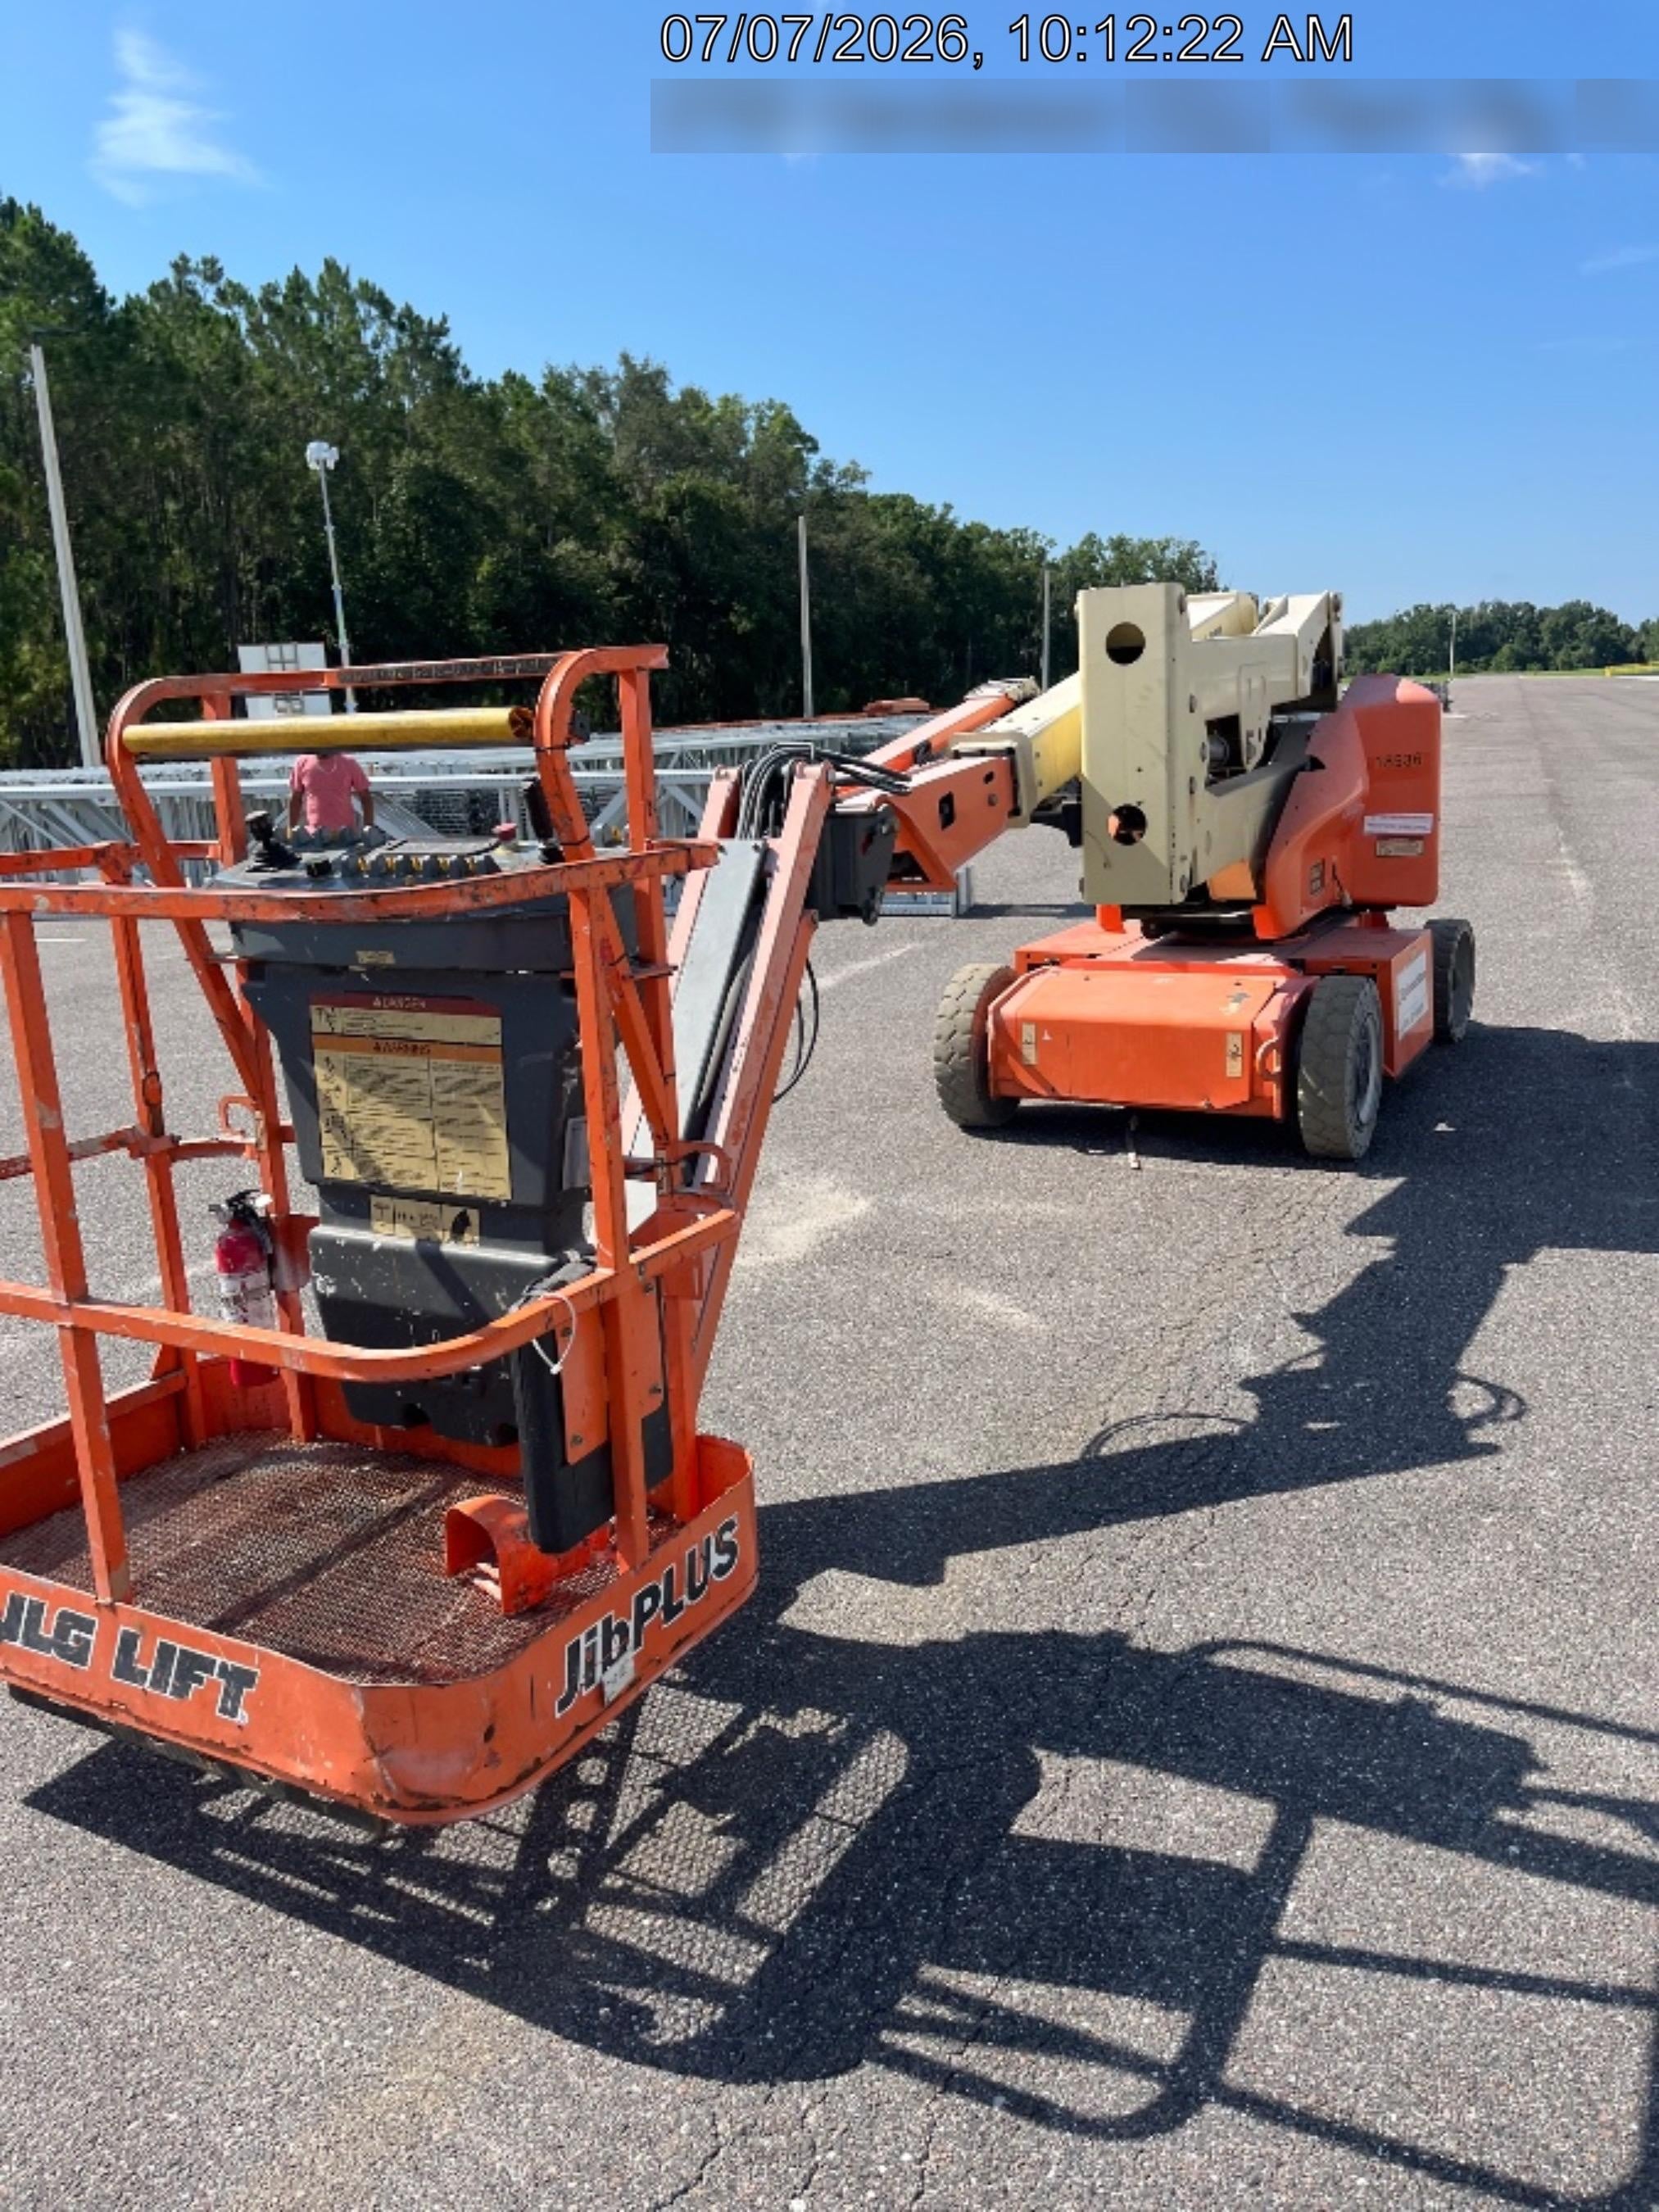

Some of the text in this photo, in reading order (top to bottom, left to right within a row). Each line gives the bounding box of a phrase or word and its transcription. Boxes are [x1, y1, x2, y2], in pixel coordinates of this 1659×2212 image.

[0, 1590, 261, 1722] JLG LIFT
[555, 1512, 739, 1718] JibPLUS
